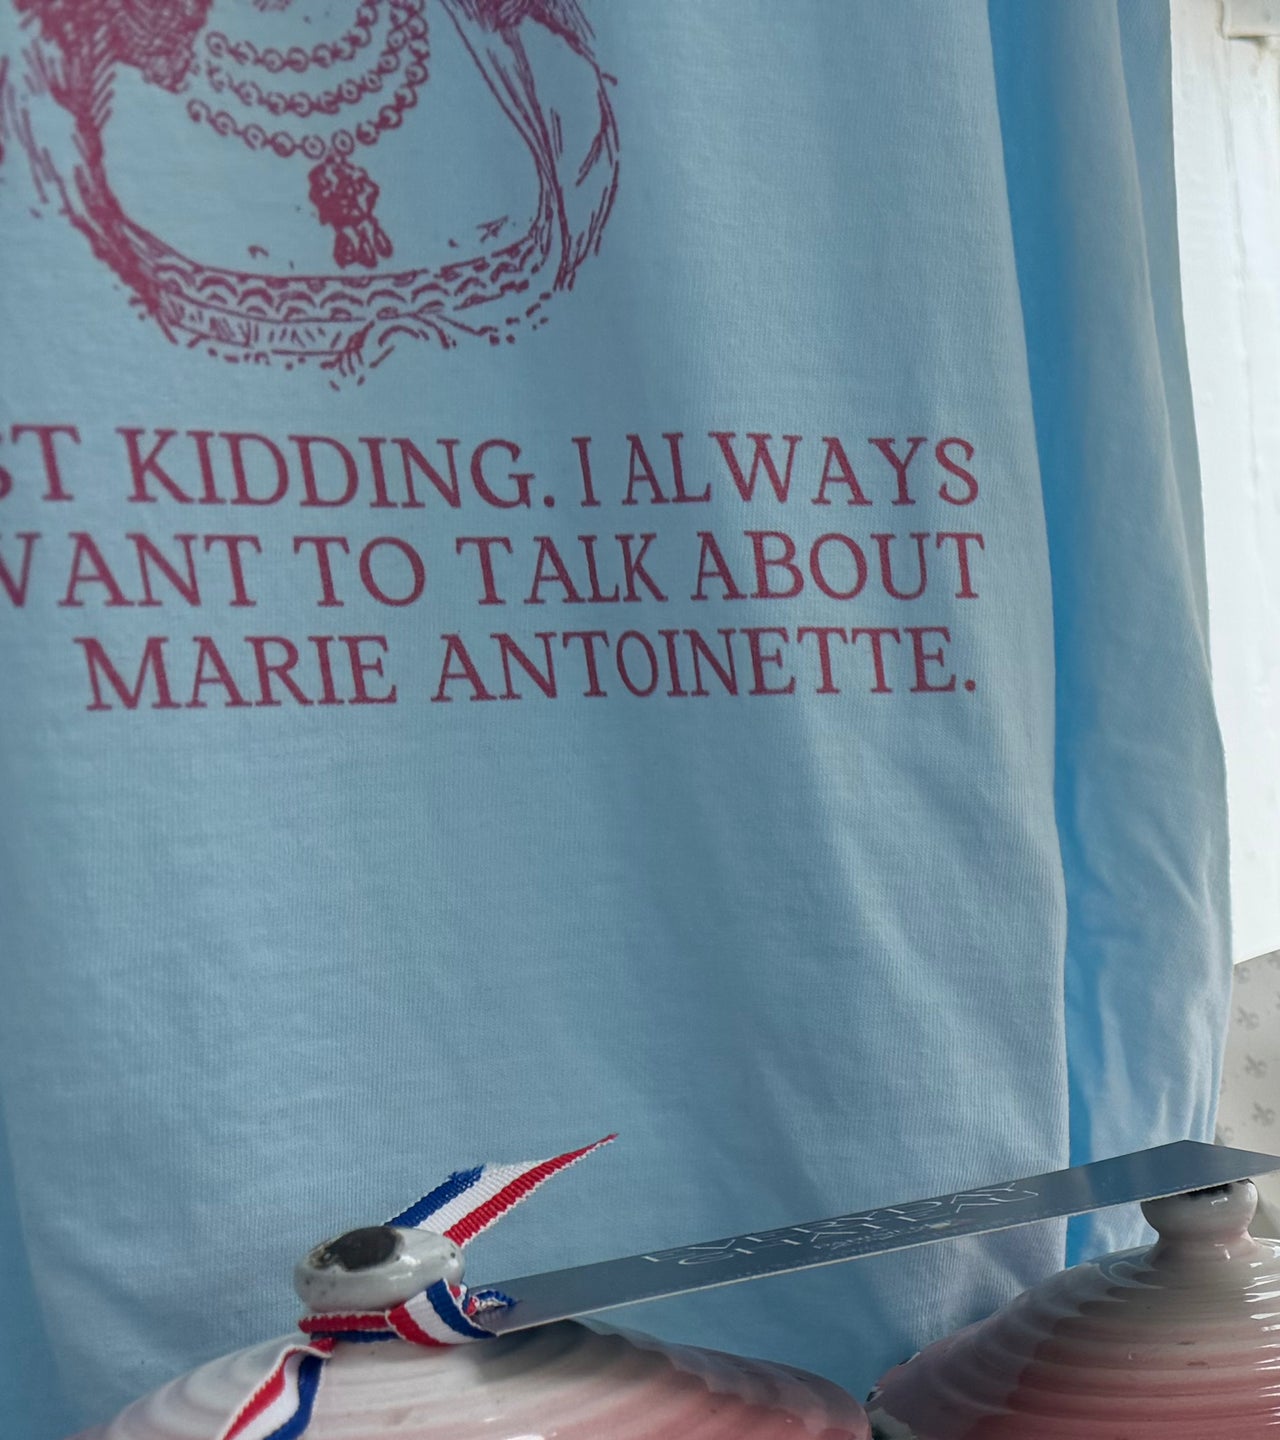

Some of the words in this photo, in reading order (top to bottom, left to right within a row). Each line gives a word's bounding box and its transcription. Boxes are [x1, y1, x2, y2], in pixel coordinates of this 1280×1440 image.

[0, 425, 80, 502] T
[115, 429, 556, 509] KIDDING.
[572, 435, 602, 508] I
[622, 431, 980, 507] ALWAYS
[294, 535, 427, 605] TO
[456, 531, 669, 605] TALK
[691, 529, 985, 601] ABOUT
[73, 634, 398, 710] MARIE
[431, 625, 977, 704] ANTOINETTE.
[642, 1182, 1016, 1263] EVERYDAY
